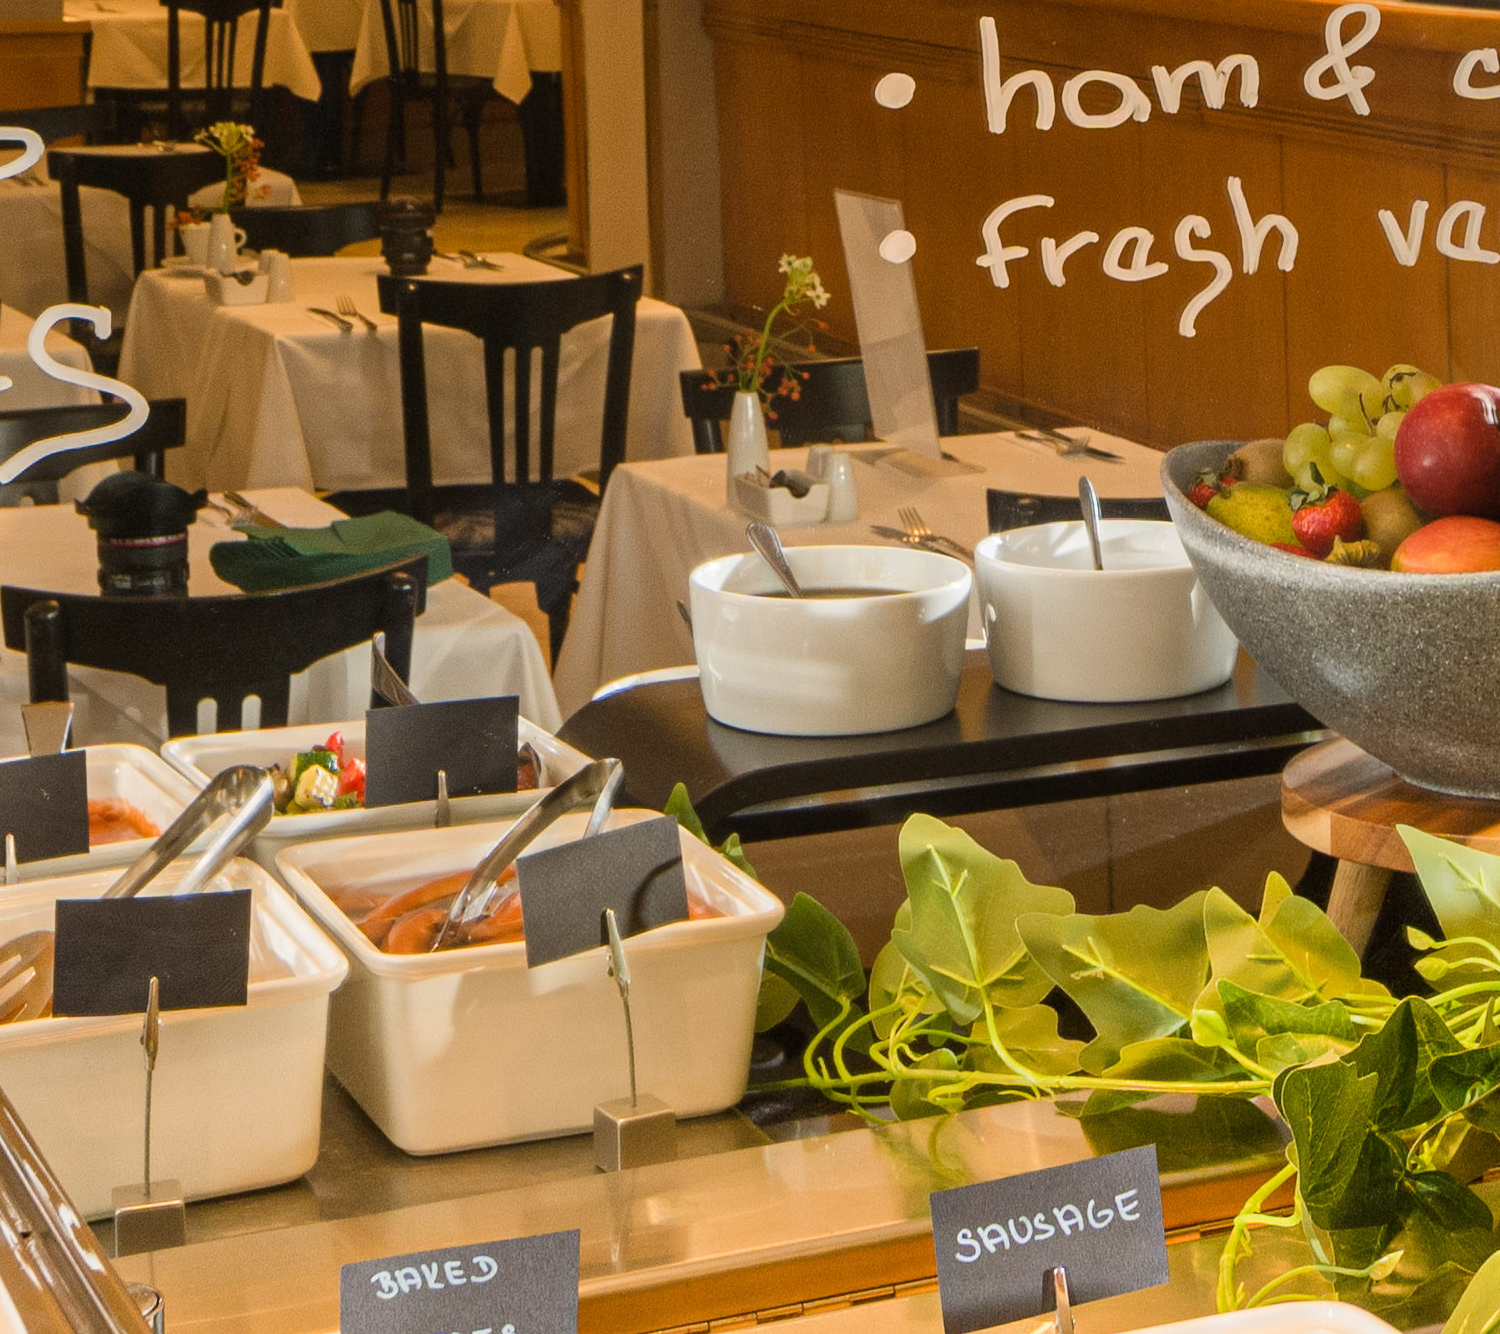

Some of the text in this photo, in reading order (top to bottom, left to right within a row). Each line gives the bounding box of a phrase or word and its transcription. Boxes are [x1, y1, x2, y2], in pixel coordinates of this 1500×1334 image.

[979, 14, 1261, 136] ham
[1301, 1, 1387, 117] &
[977, 173, 1299, 338] fresh
[370, 1255, 498, 1300] BAKED
[955, 1188, 1141, 1263] SAUSAGE
